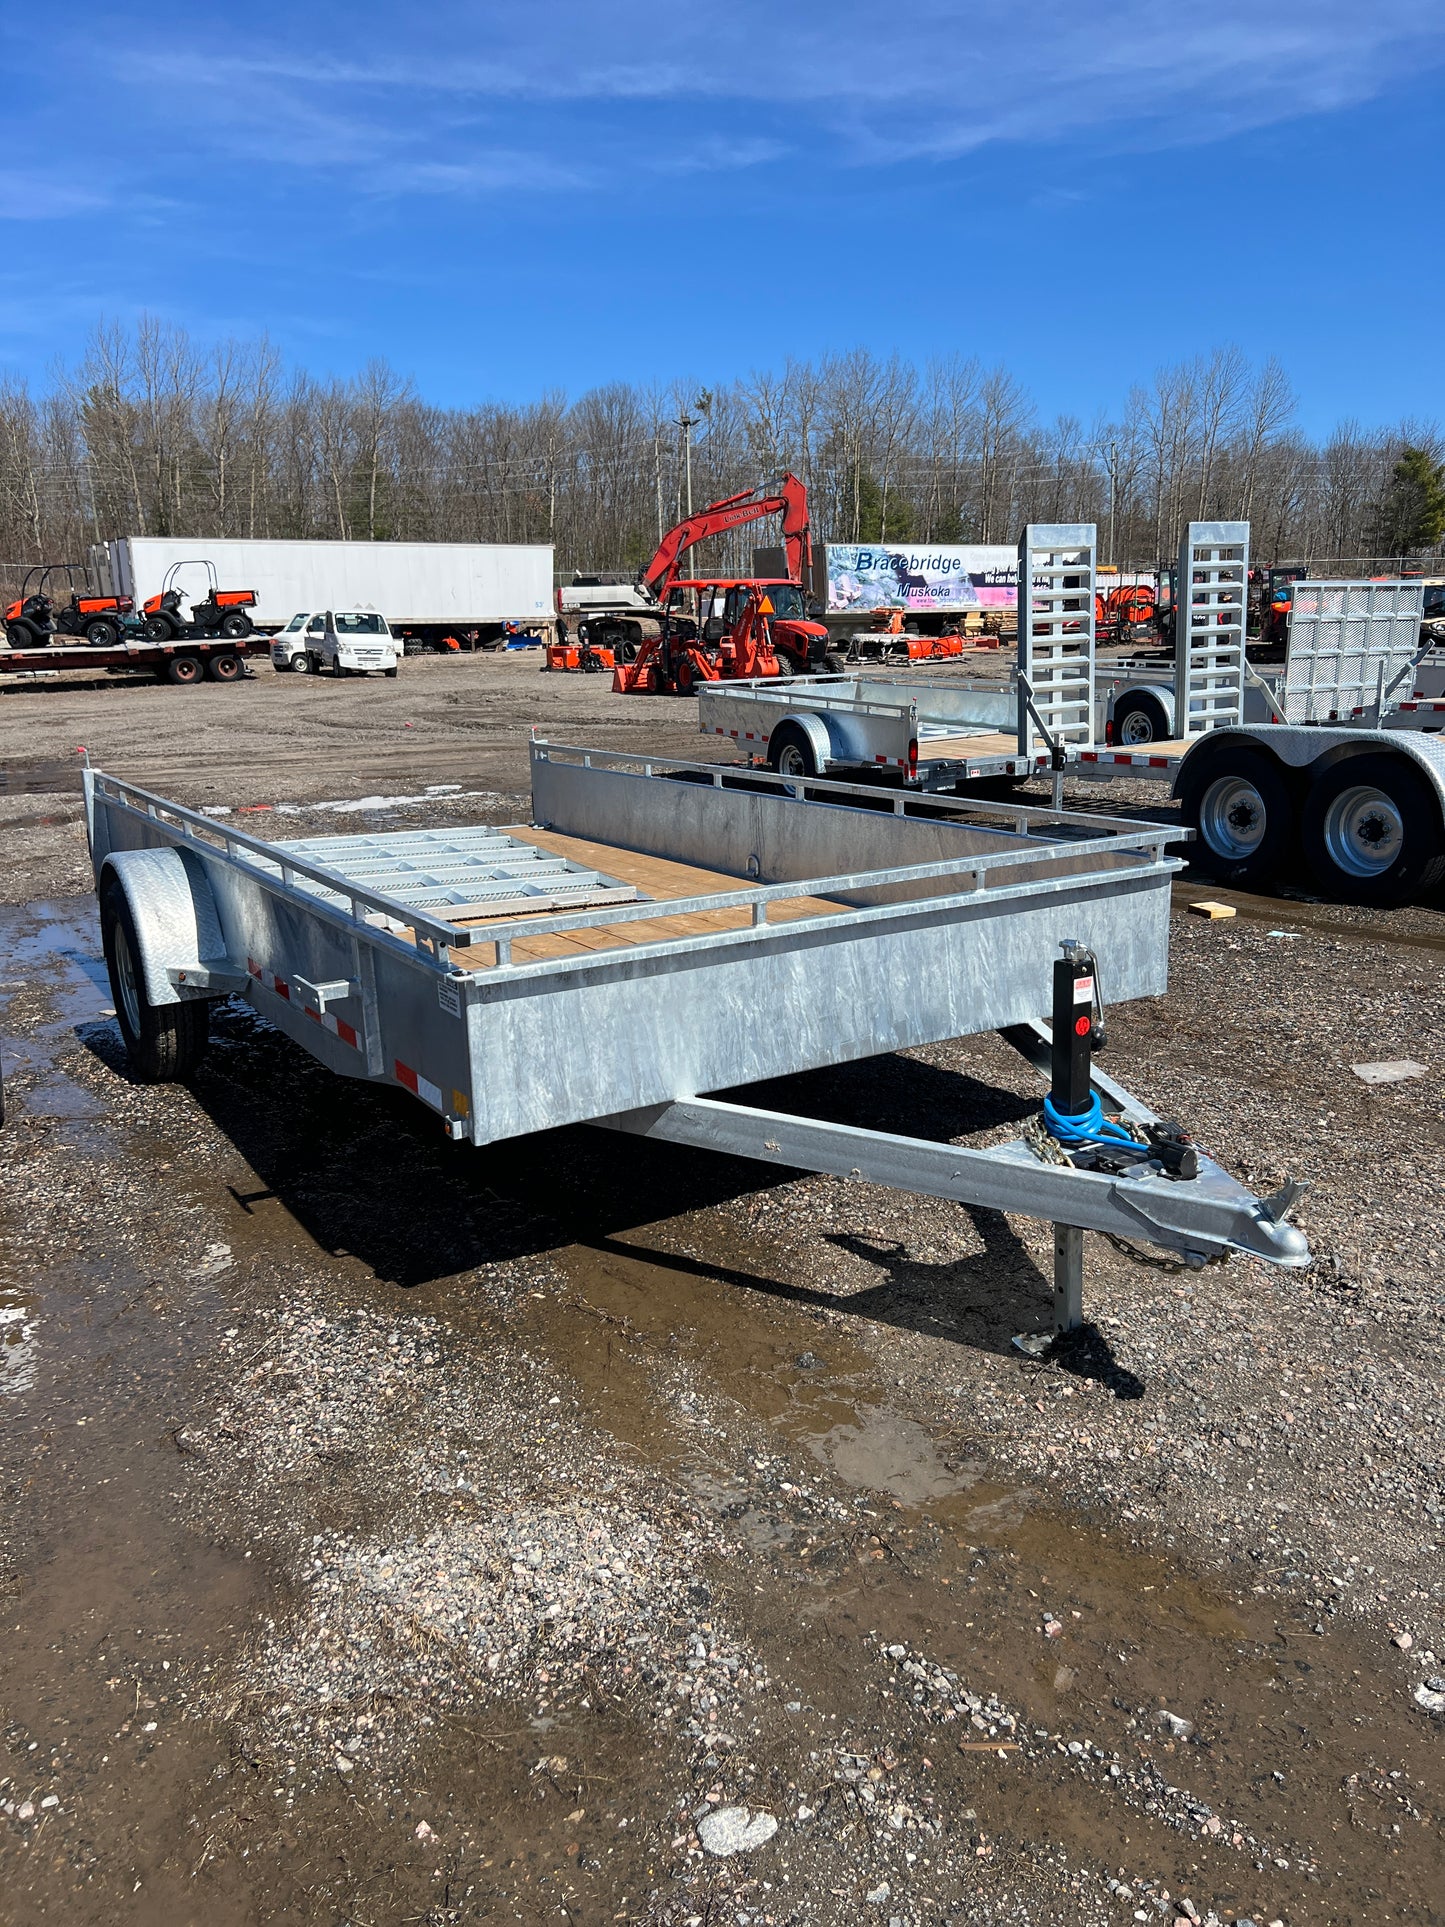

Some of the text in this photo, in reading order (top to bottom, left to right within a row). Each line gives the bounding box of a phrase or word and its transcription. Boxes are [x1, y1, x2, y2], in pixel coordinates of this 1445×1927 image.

[855, 552, 961, 573] Bracebridge
[985, 573, 995, 584] We
[995, 575, 1006, 584] can
[896, 583, 951, 598] Muskoka
